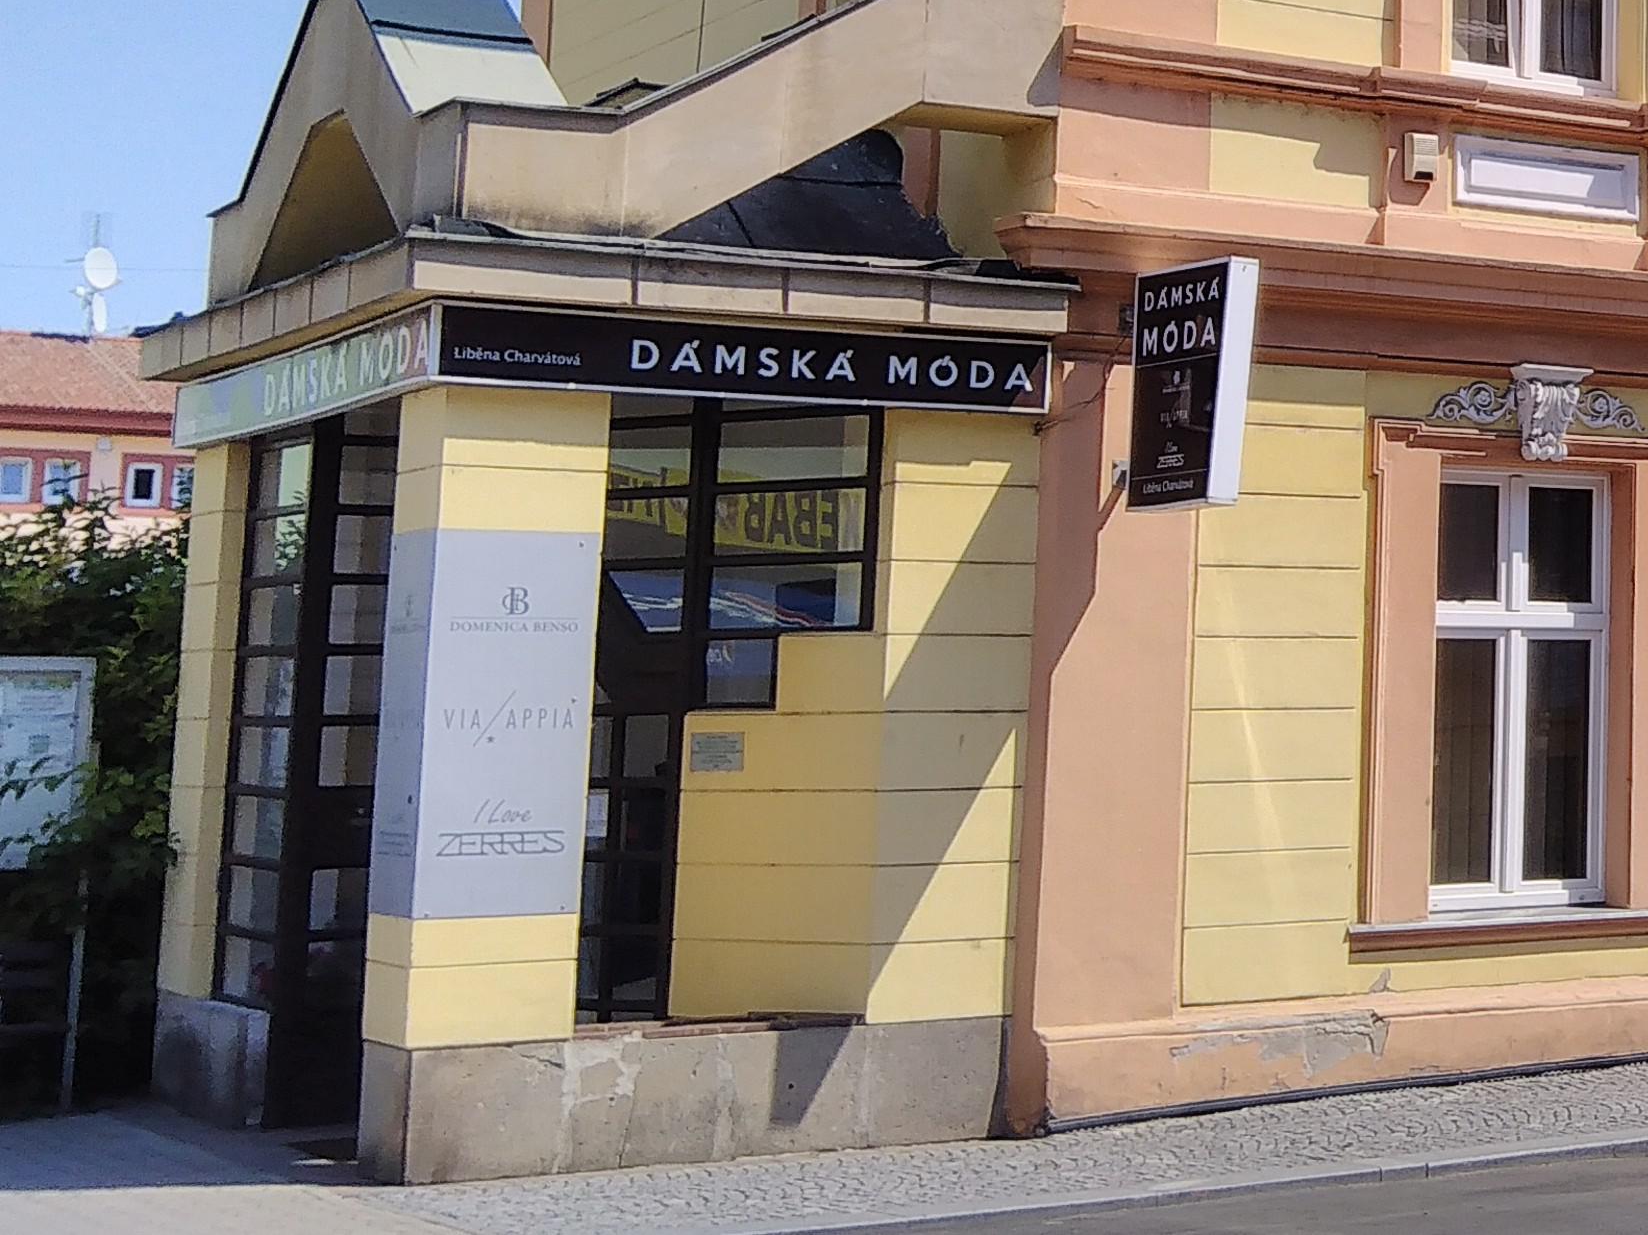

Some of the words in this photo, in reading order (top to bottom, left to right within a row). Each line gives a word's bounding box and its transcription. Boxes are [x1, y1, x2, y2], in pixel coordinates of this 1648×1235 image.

[1143, 276, 1220, 312] DÁMSKÁ
[1142, 316, 1216, 357] MÓDA
[453, 346, 500, 361] Liběna
[504, 349, 582, 366] Charvátová
[630, 338, 856, 382] DÁMSKÁ
[887, 355, 1033, 392] MÓDA
[450, 620, 529, 633] DOMENICA
[532, 621, 579, 633] BENSO
[488, 799, 532, 824] Love
[436, 830, 566, 857] ZERRES
